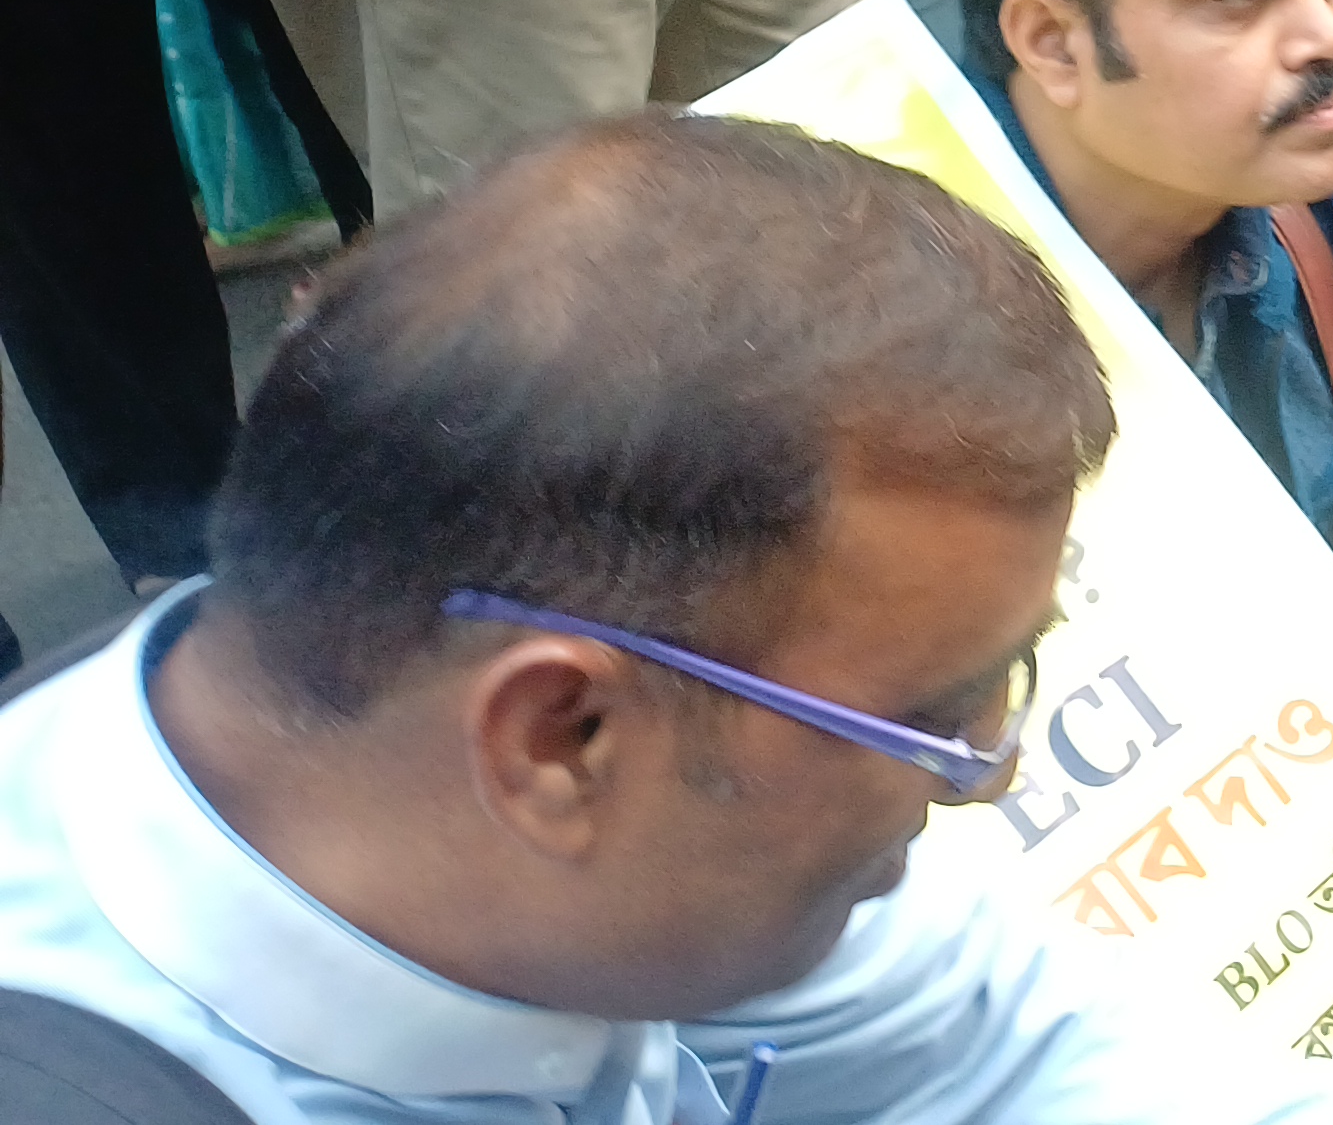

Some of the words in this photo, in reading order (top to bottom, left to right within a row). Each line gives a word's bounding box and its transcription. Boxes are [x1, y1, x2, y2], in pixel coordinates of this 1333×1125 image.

[995, 655, 1182, 853] ECI
[1050, 805, 1206, 936] বাব
[1212, 909, 1314, 1012] BLO
